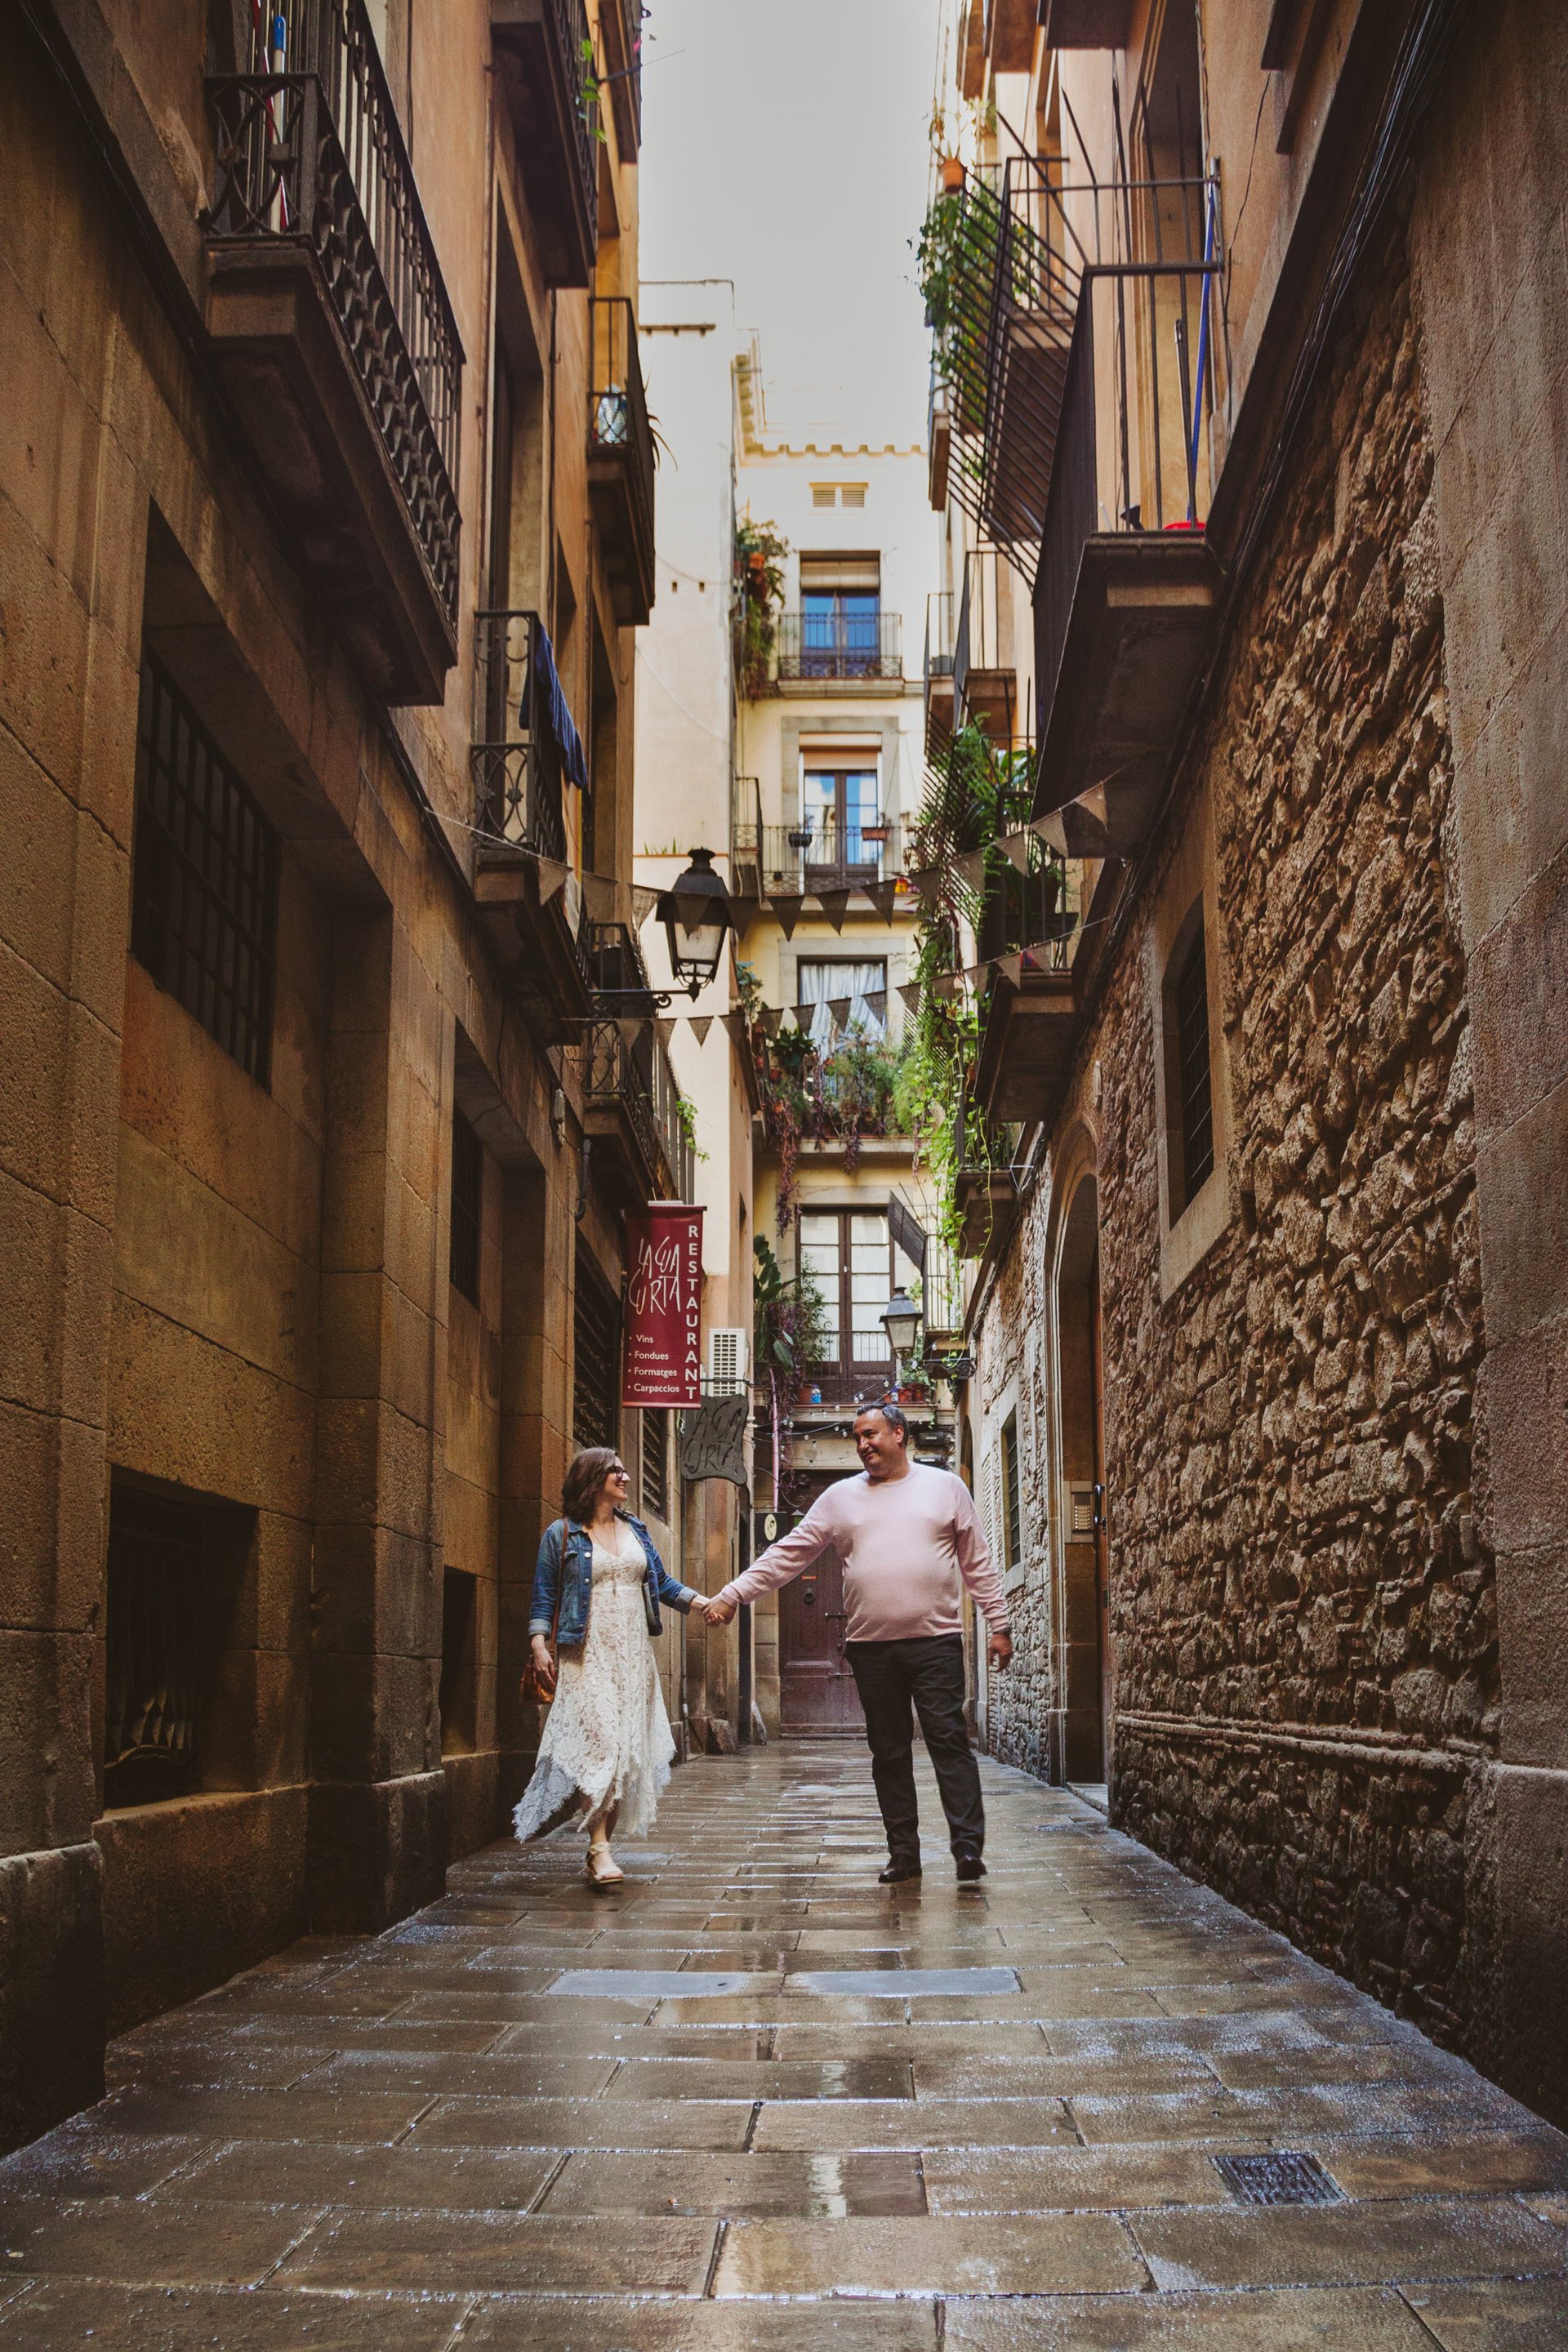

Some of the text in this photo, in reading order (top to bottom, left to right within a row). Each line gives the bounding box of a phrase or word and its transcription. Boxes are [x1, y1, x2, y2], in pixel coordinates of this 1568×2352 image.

[684, 1225, 699, 1400] RESTAURANT
[636, 1334, 654, 1343] Vins
[635, 1350, 669, 1360] Fondues
[634, 1367, 677, 1379] Formatges
[634, 1383, 679, 1394] Carpaccios
